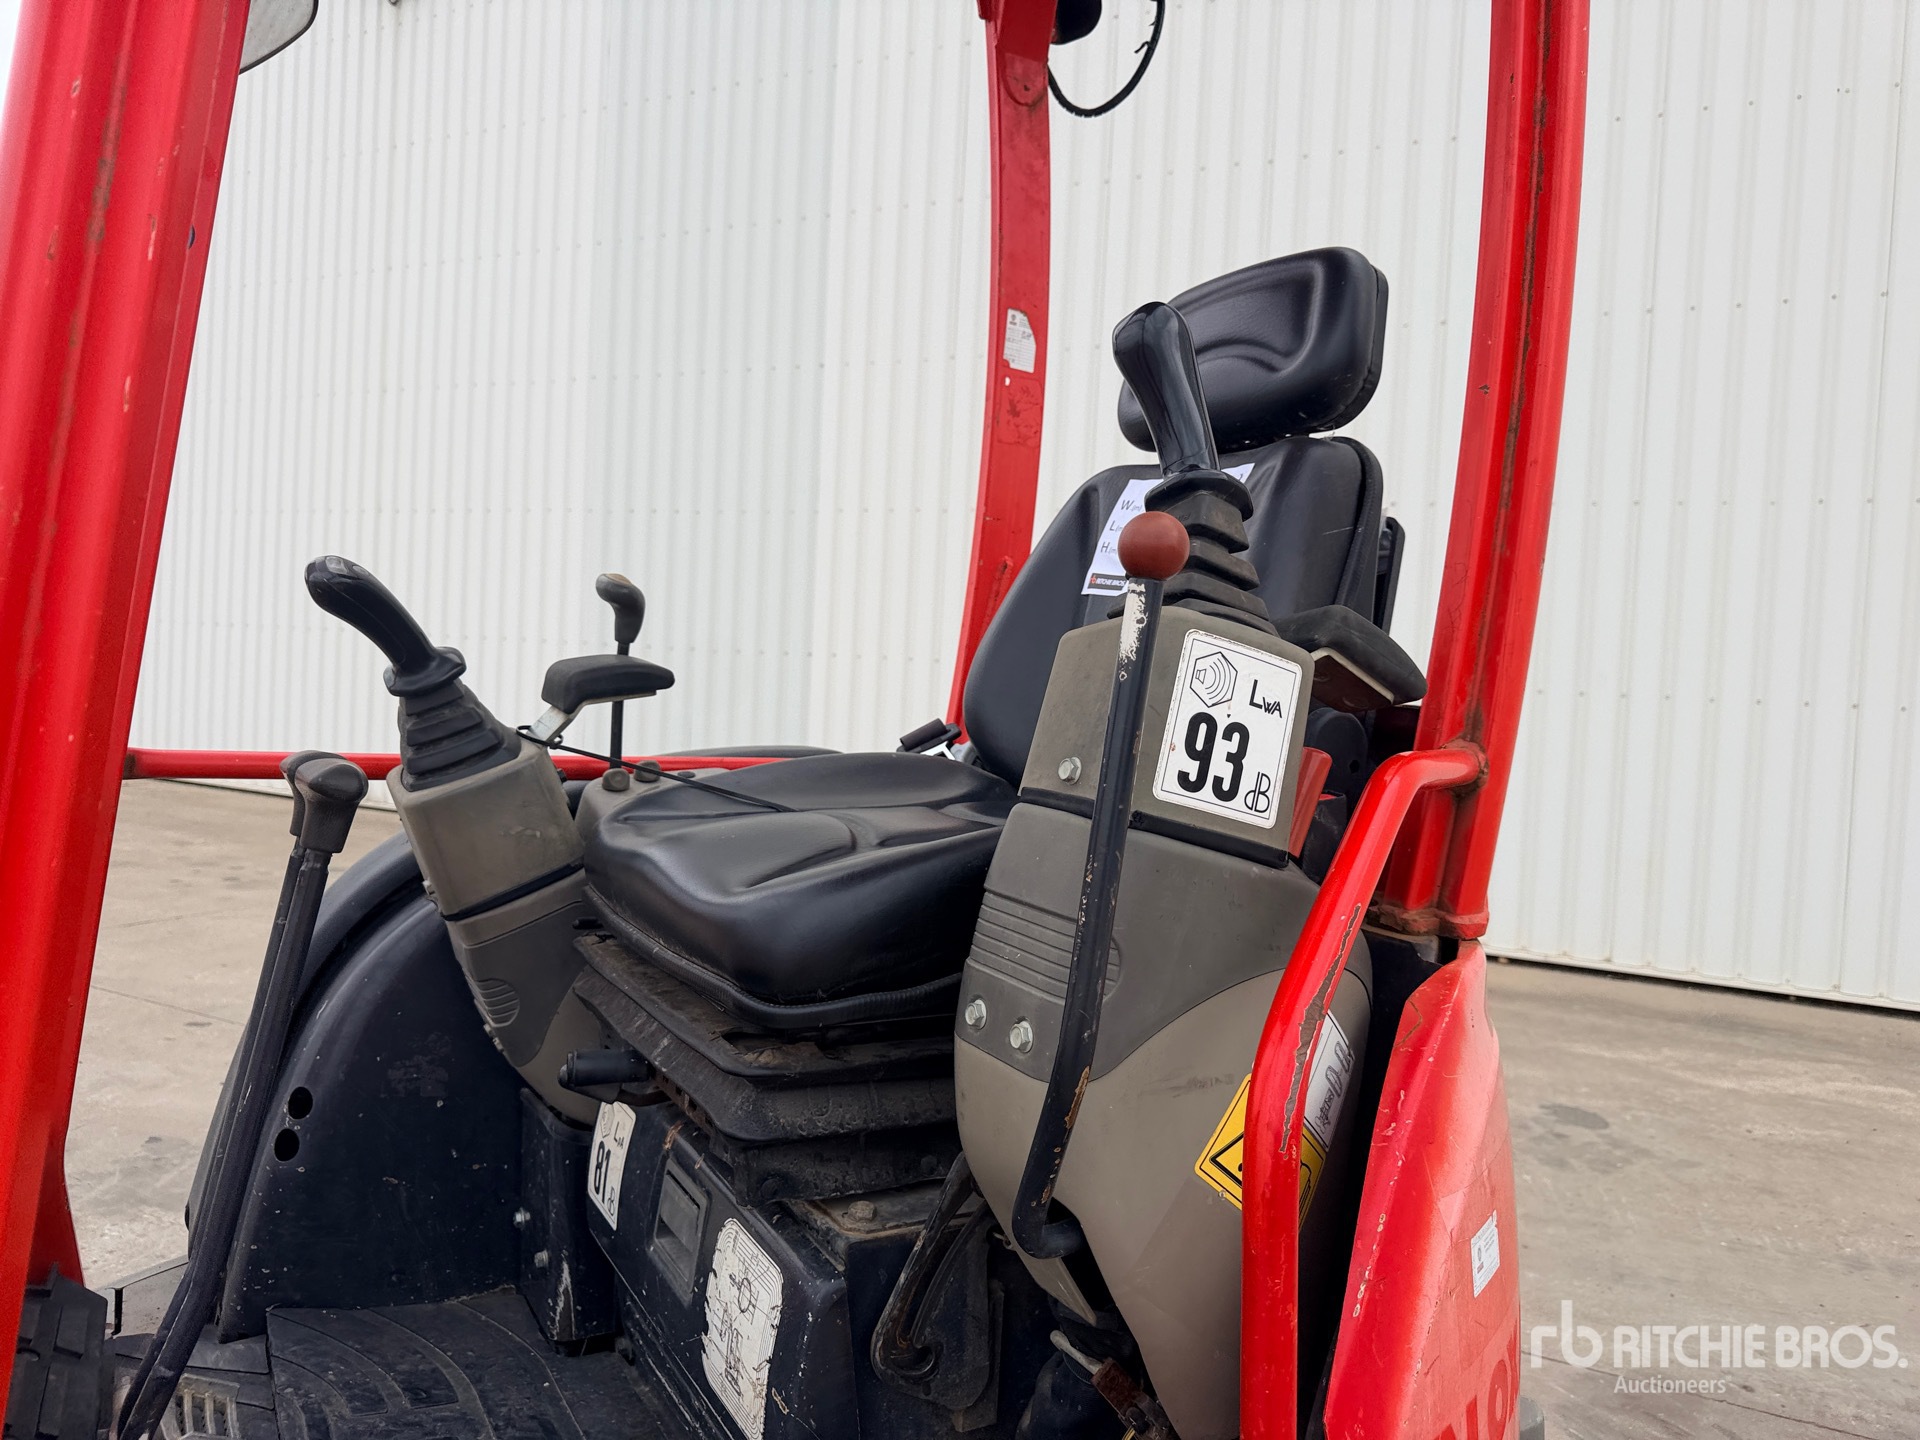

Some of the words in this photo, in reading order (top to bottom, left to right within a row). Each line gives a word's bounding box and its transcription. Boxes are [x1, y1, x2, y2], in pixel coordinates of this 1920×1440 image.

[1177, 711, 1250, 802] 93
[1244, 771, 1272, 813] dB
[594, 1140, 611, 1204] 81
